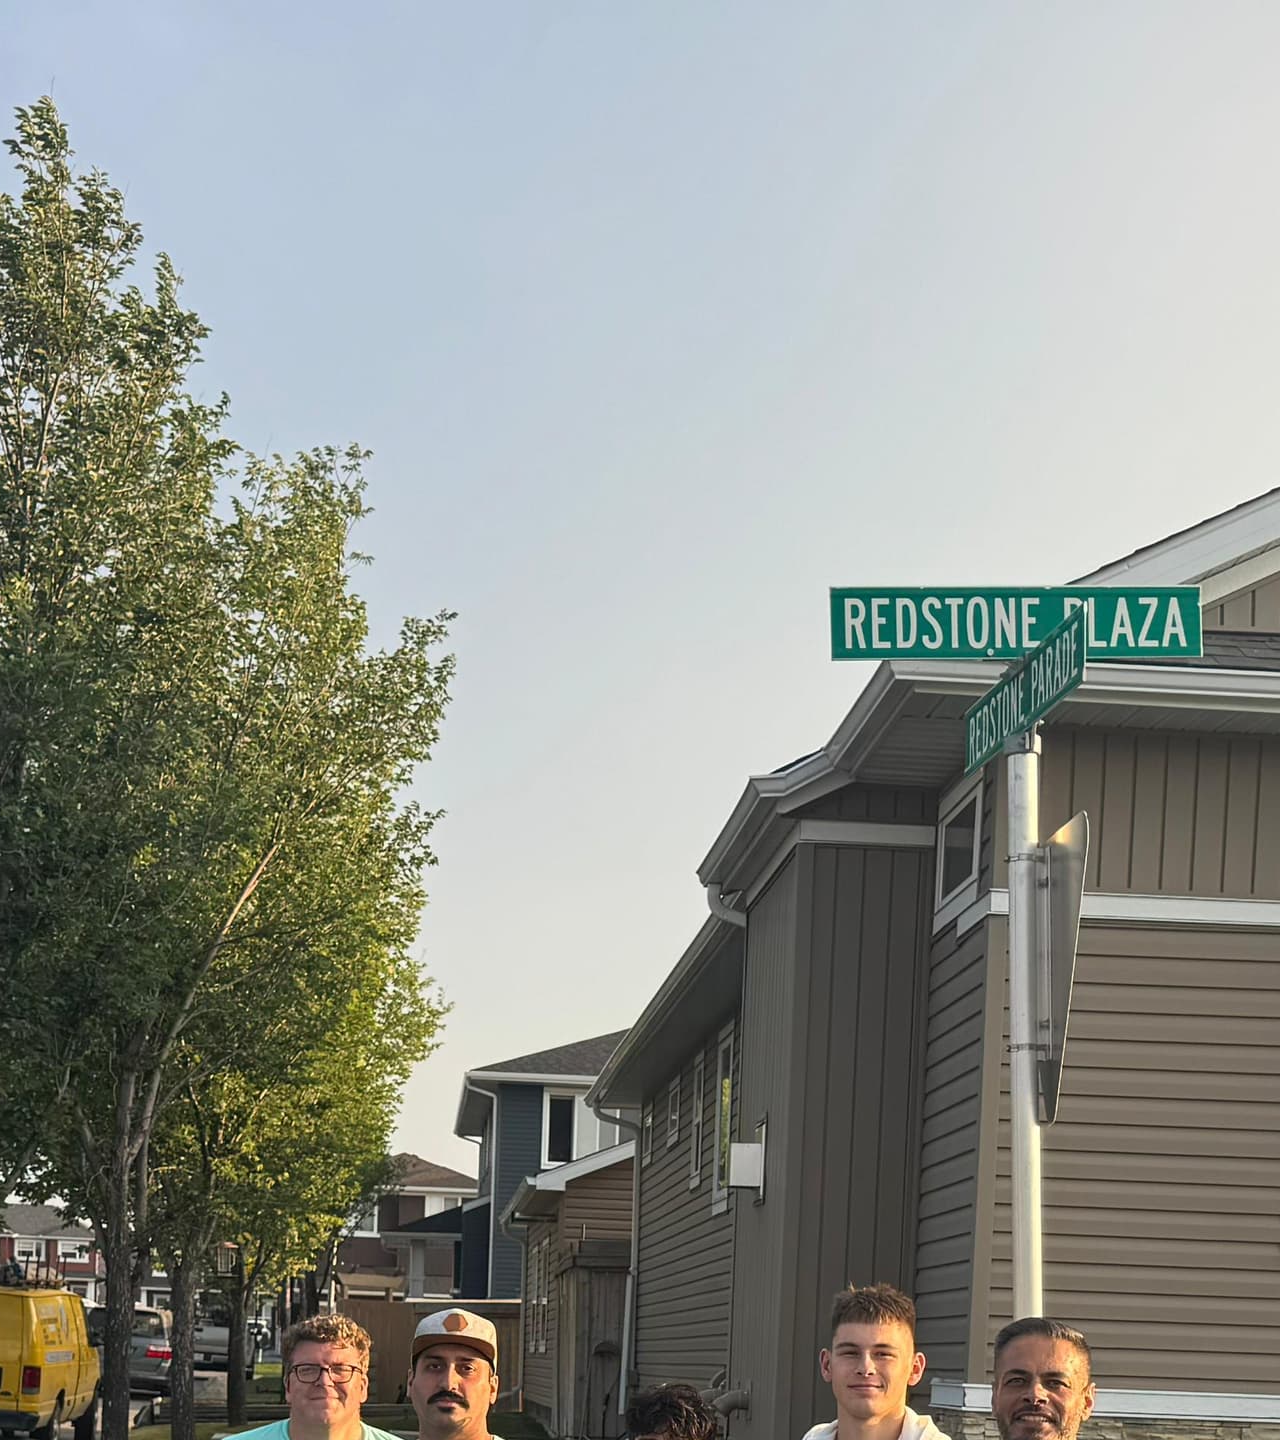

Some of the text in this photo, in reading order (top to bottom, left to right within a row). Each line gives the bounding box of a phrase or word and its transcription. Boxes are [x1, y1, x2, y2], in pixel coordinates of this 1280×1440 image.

[843, 596, 1041, 649] REDSTONE
[968, 622, 1079, 766] REDSTONE PARADE
